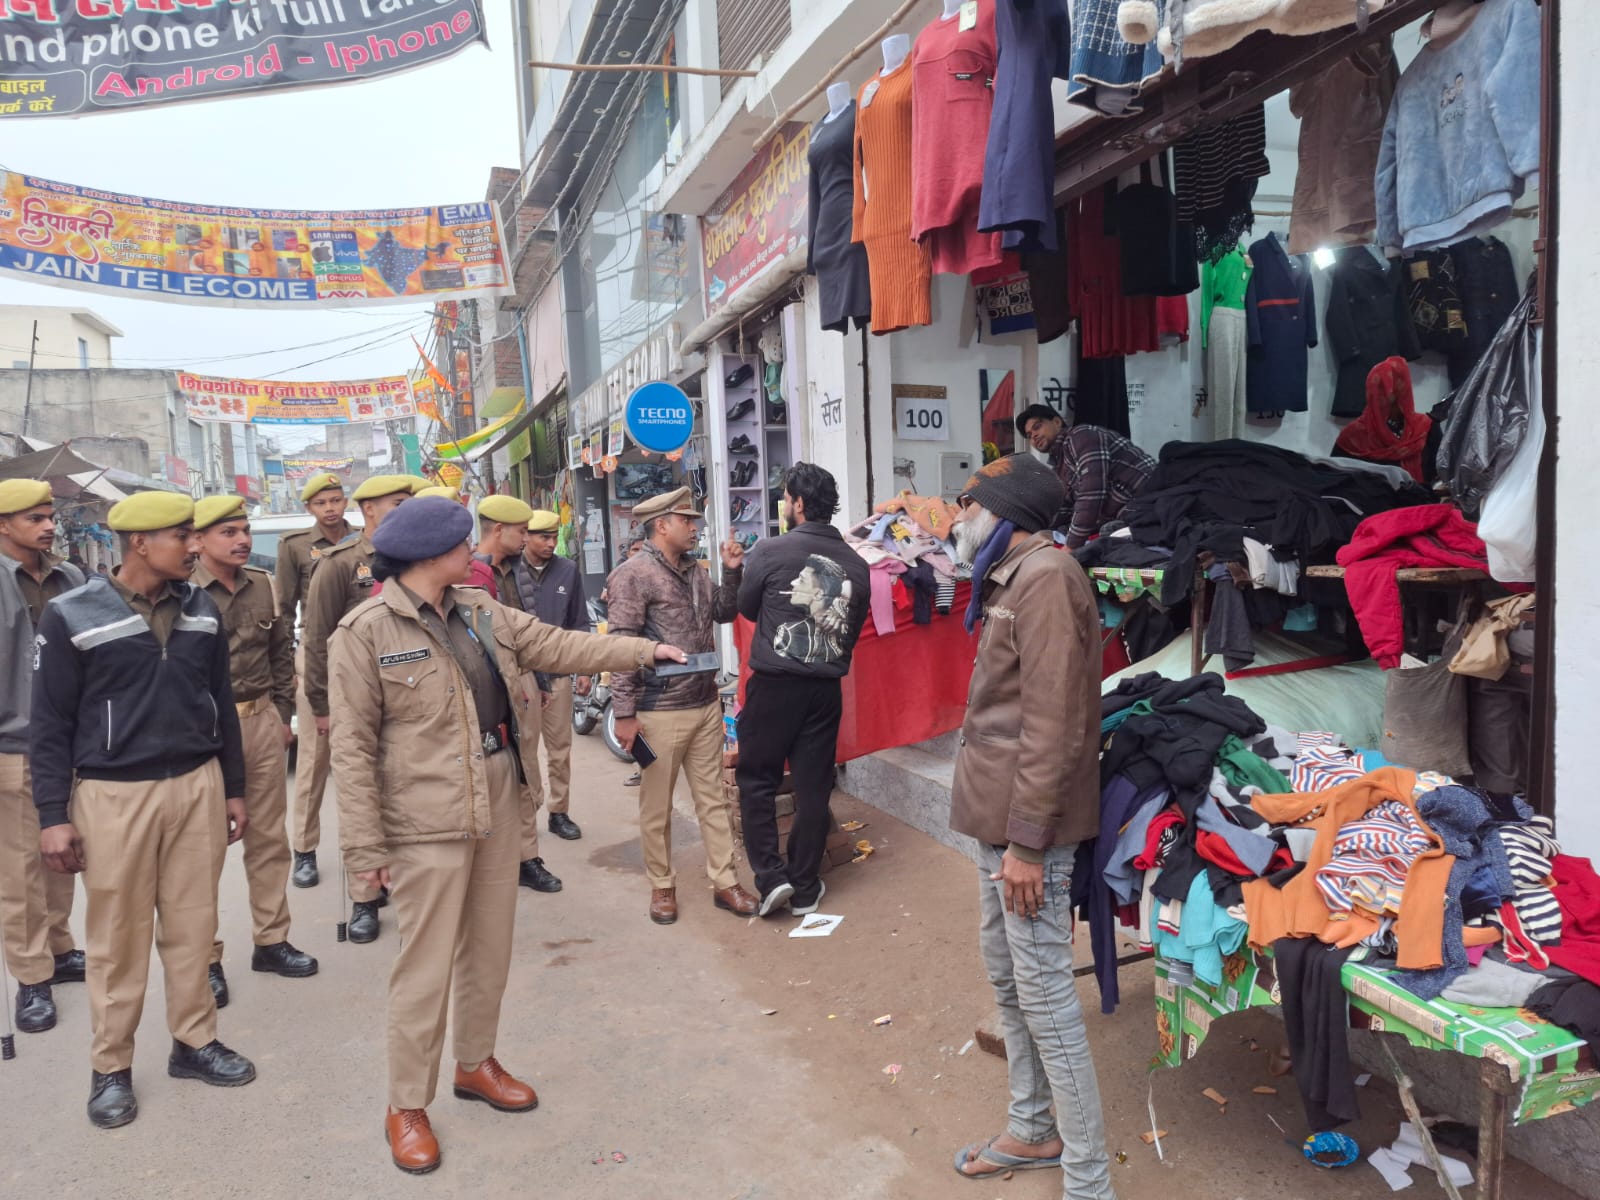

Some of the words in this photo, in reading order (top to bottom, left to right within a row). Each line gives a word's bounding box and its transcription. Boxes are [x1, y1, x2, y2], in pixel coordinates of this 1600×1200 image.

[0, 28, 66, 62] nd
[82, 23, 219, 64] phone
[232, 8, 264, 41] ki
[95, 43, 283, 97] Android
[324, 10, 472, 72] Iphone
[442, 203, 486, 220] EMI
[13, 252, 99, 282] JAIN
[113, 267, 310, 300] TELECOME
[638, 408, 686, 419] TECNO
[821, 392, 842, 427] सेल
[906, 409, 943, 429] 100
